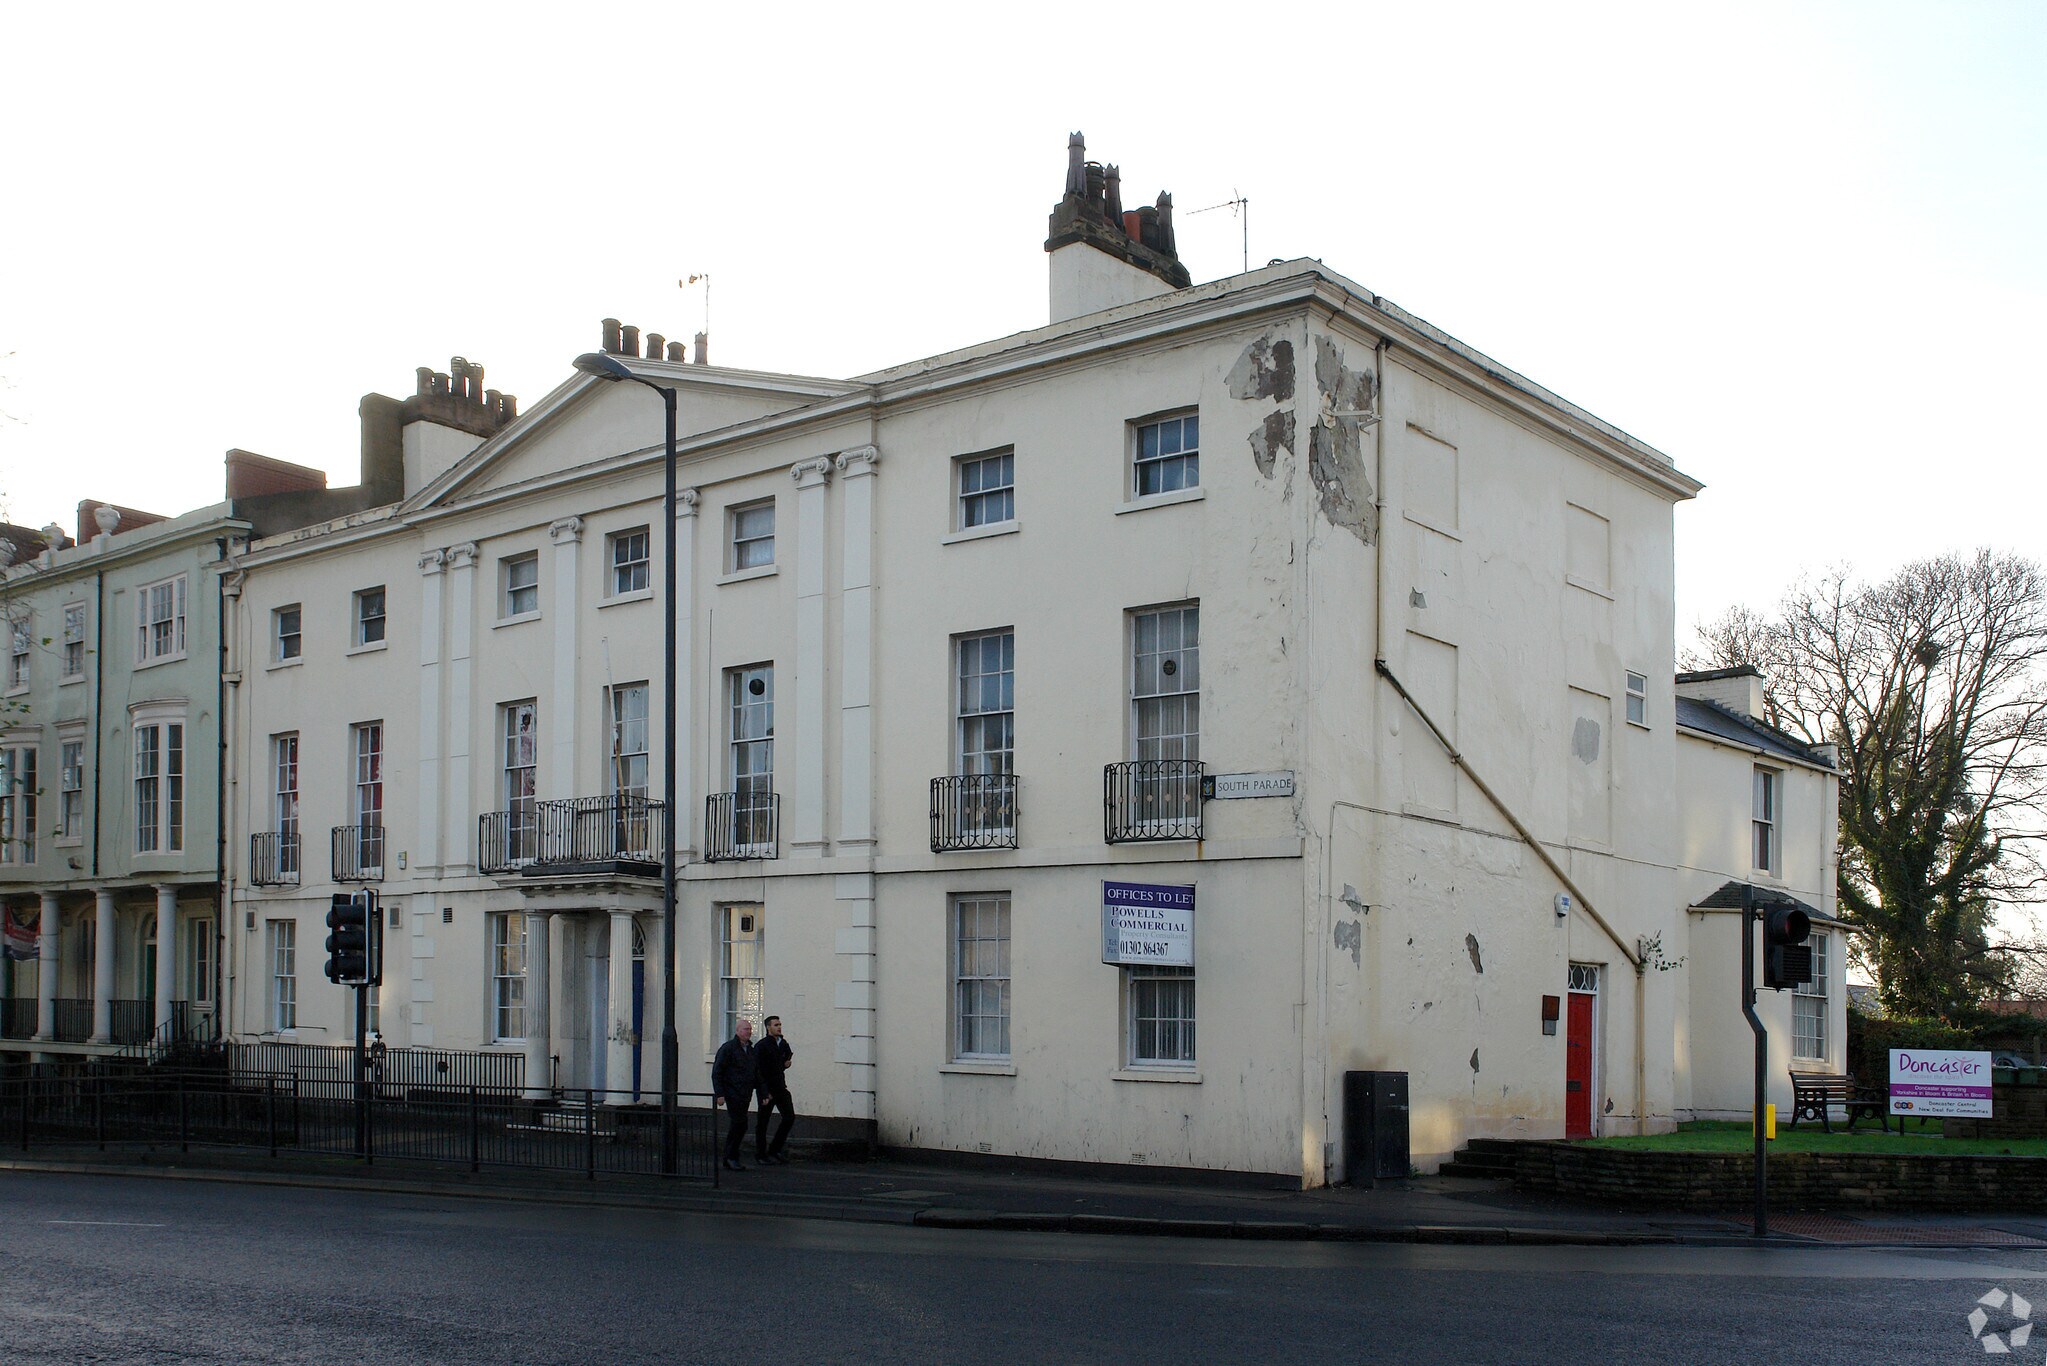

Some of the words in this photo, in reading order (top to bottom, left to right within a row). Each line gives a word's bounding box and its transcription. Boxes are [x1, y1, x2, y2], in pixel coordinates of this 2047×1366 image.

[1218, 781, 1249, 792] SOUTH
[1253, 779, 1291, 790] PARADE
[1107, 888, 1154, 901] OFFICES
[1156, 891, 1172, 902] TO
[1175, 893, 1194, 904] LET
[1111, 906, 1164, 919] POWELLS
[1111, 919, 1187, 931] COMMERCIAL
[1120, 941, 1142, 955] 01302
[1143, 941, 1168, 956] 864367
[1899, 1053, 1981, 1078] Doncaster
